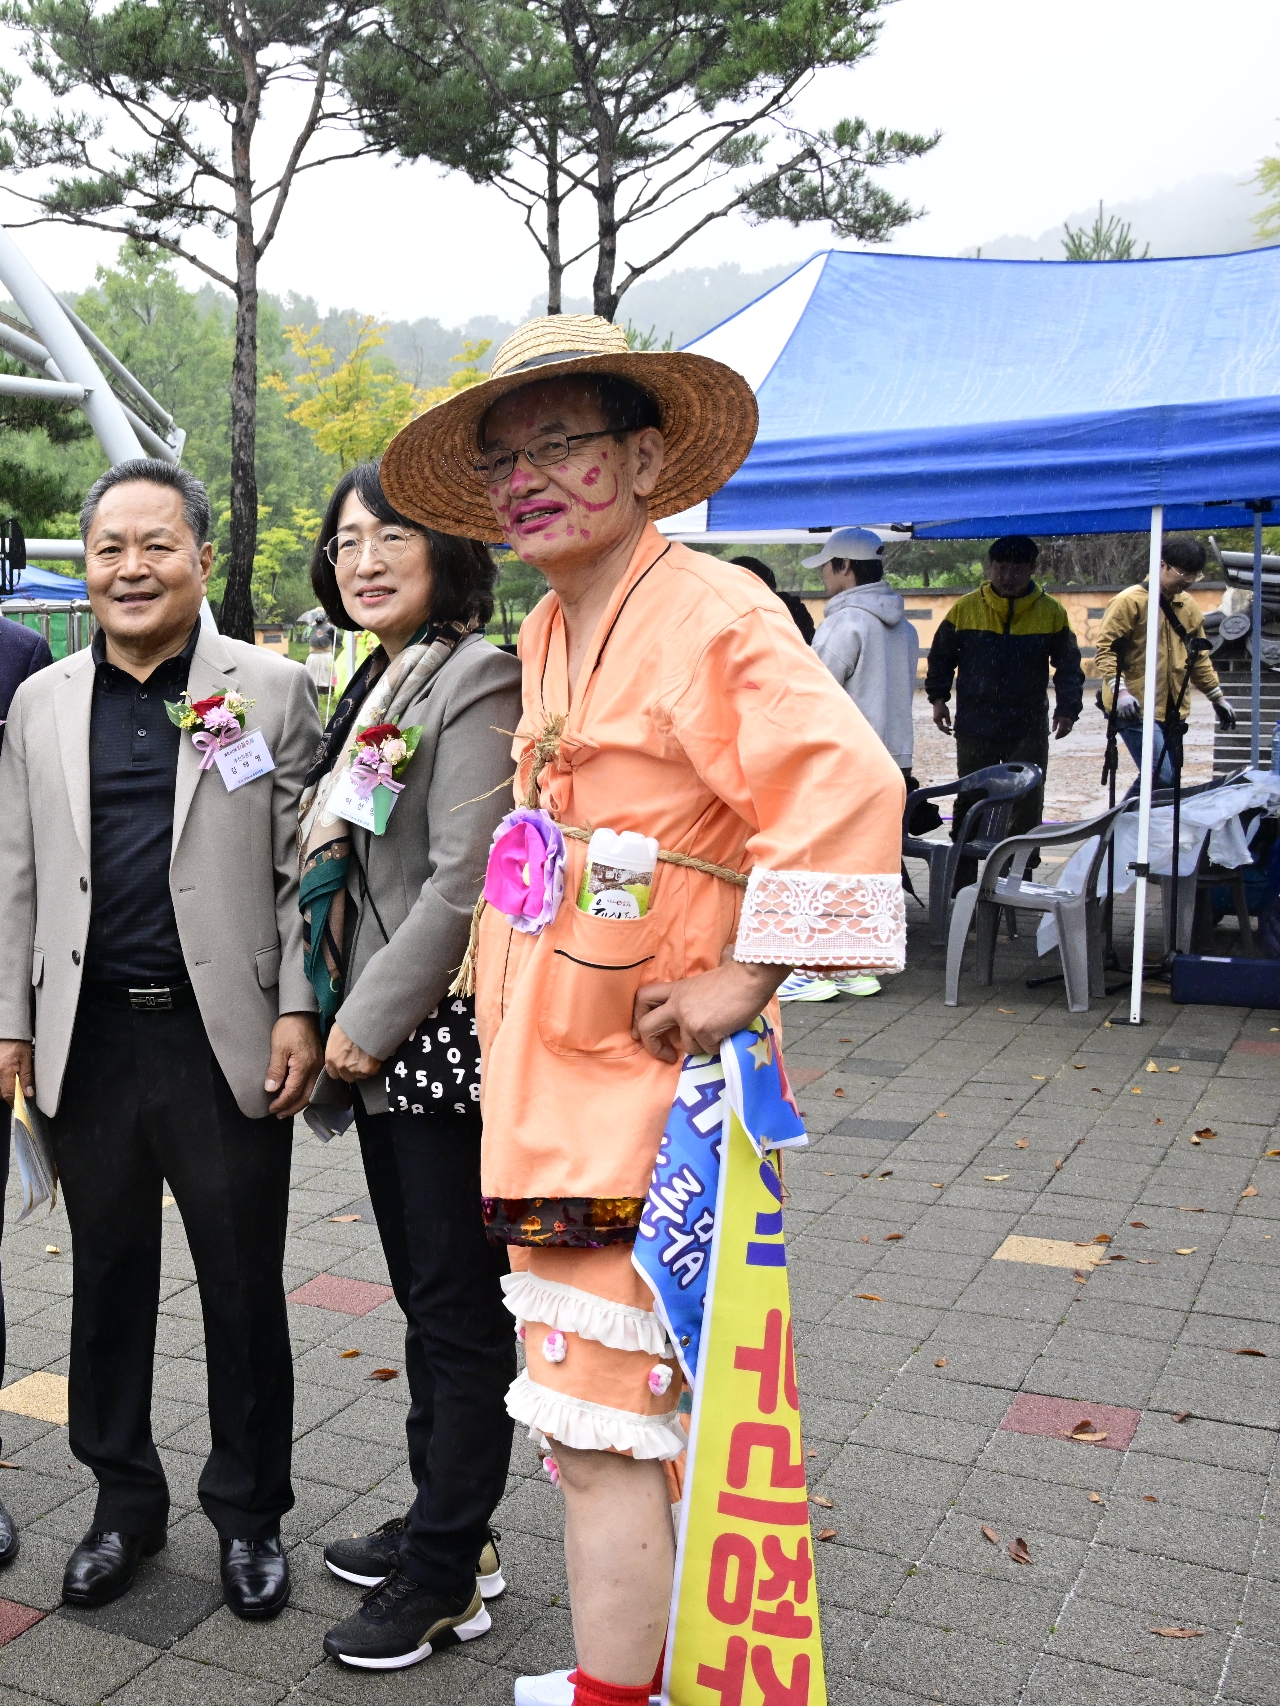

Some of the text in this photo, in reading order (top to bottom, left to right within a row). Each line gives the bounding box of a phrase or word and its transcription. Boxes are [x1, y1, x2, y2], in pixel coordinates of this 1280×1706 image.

[450, 999, 468, 1015] 4
[421, 1035, 432, 1053] 3
[437, 1026, 451, 1044] 6
[446, 1047, 461, 1064] 0
[394, 1060, 408, 1078] 4
[452, 1068, 466, 1084] 7
[415, 1069, 428, 1088] 5
[430, 1081, 444, 1099] 9
[468, 1082, 481, 1102] 8
